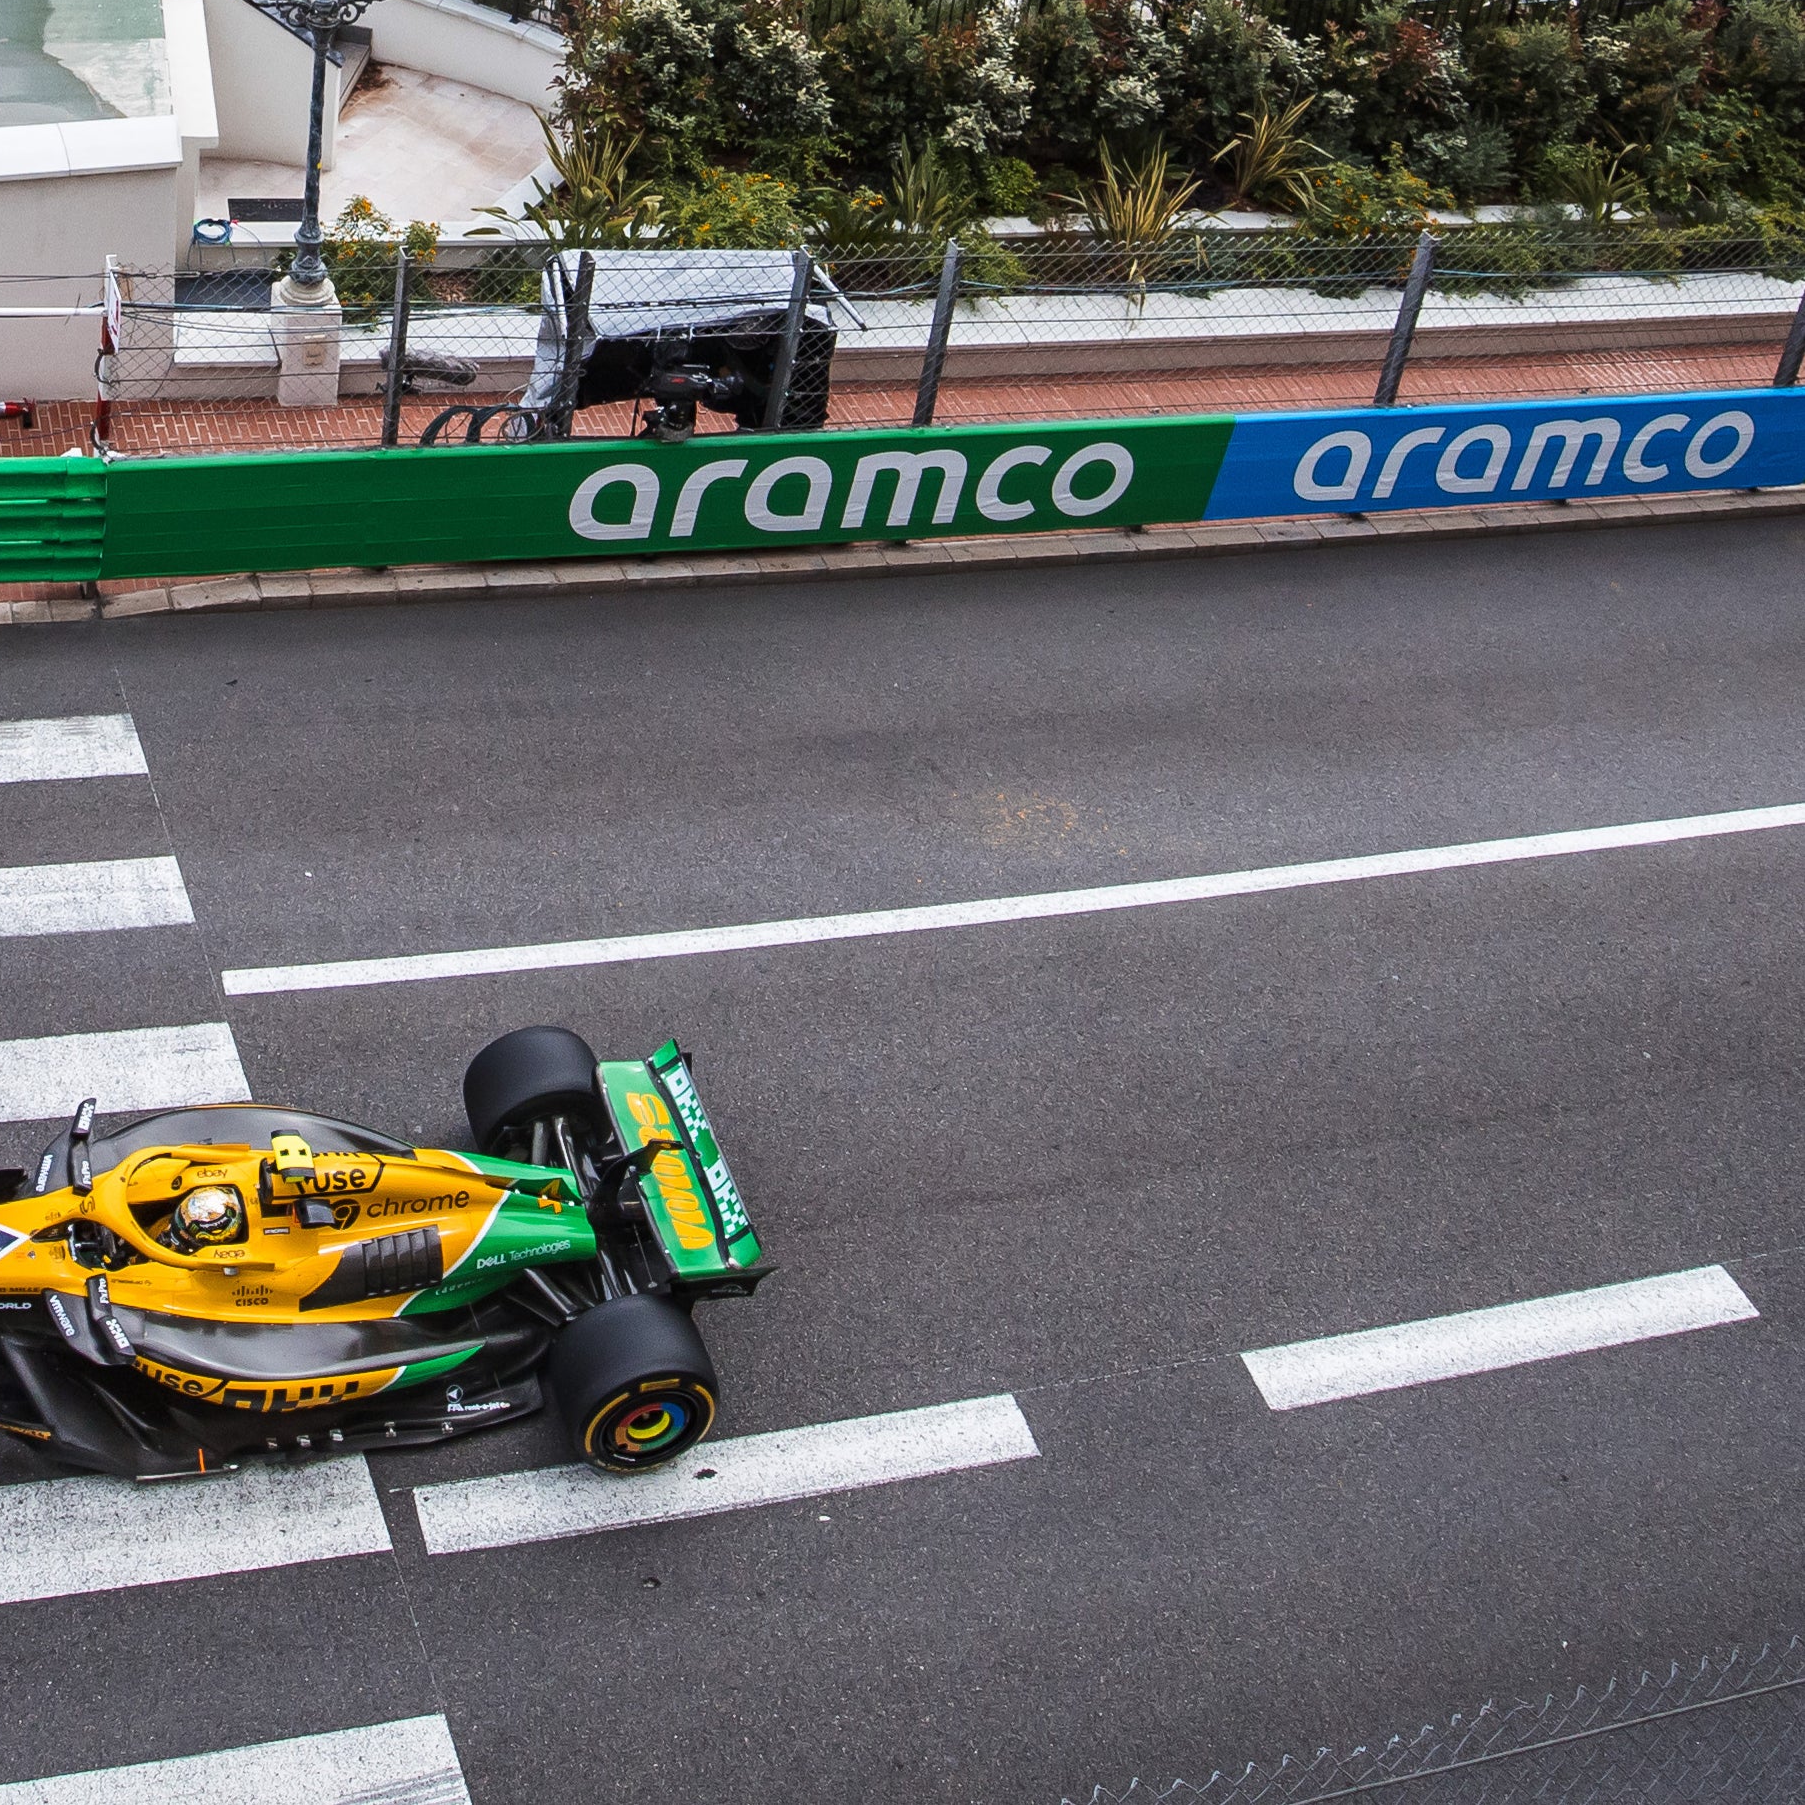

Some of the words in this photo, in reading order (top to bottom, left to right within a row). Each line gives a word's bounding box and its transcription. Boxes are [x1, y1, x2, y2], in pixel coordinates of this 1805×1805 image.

[1293, 410, 1755, 502] aramco
[568, 442, 1134, 540] aramco
[196, 1167, 228, 1178] ebay
[366, 1190, 469, 1218] chrome
[213, 1248, 245, 1259] ebay
[476, 1253, 507, 1269] DELL
[509, 1239, 571, 1261] Technologies
[49, 1294, 76, 1337] vmware
